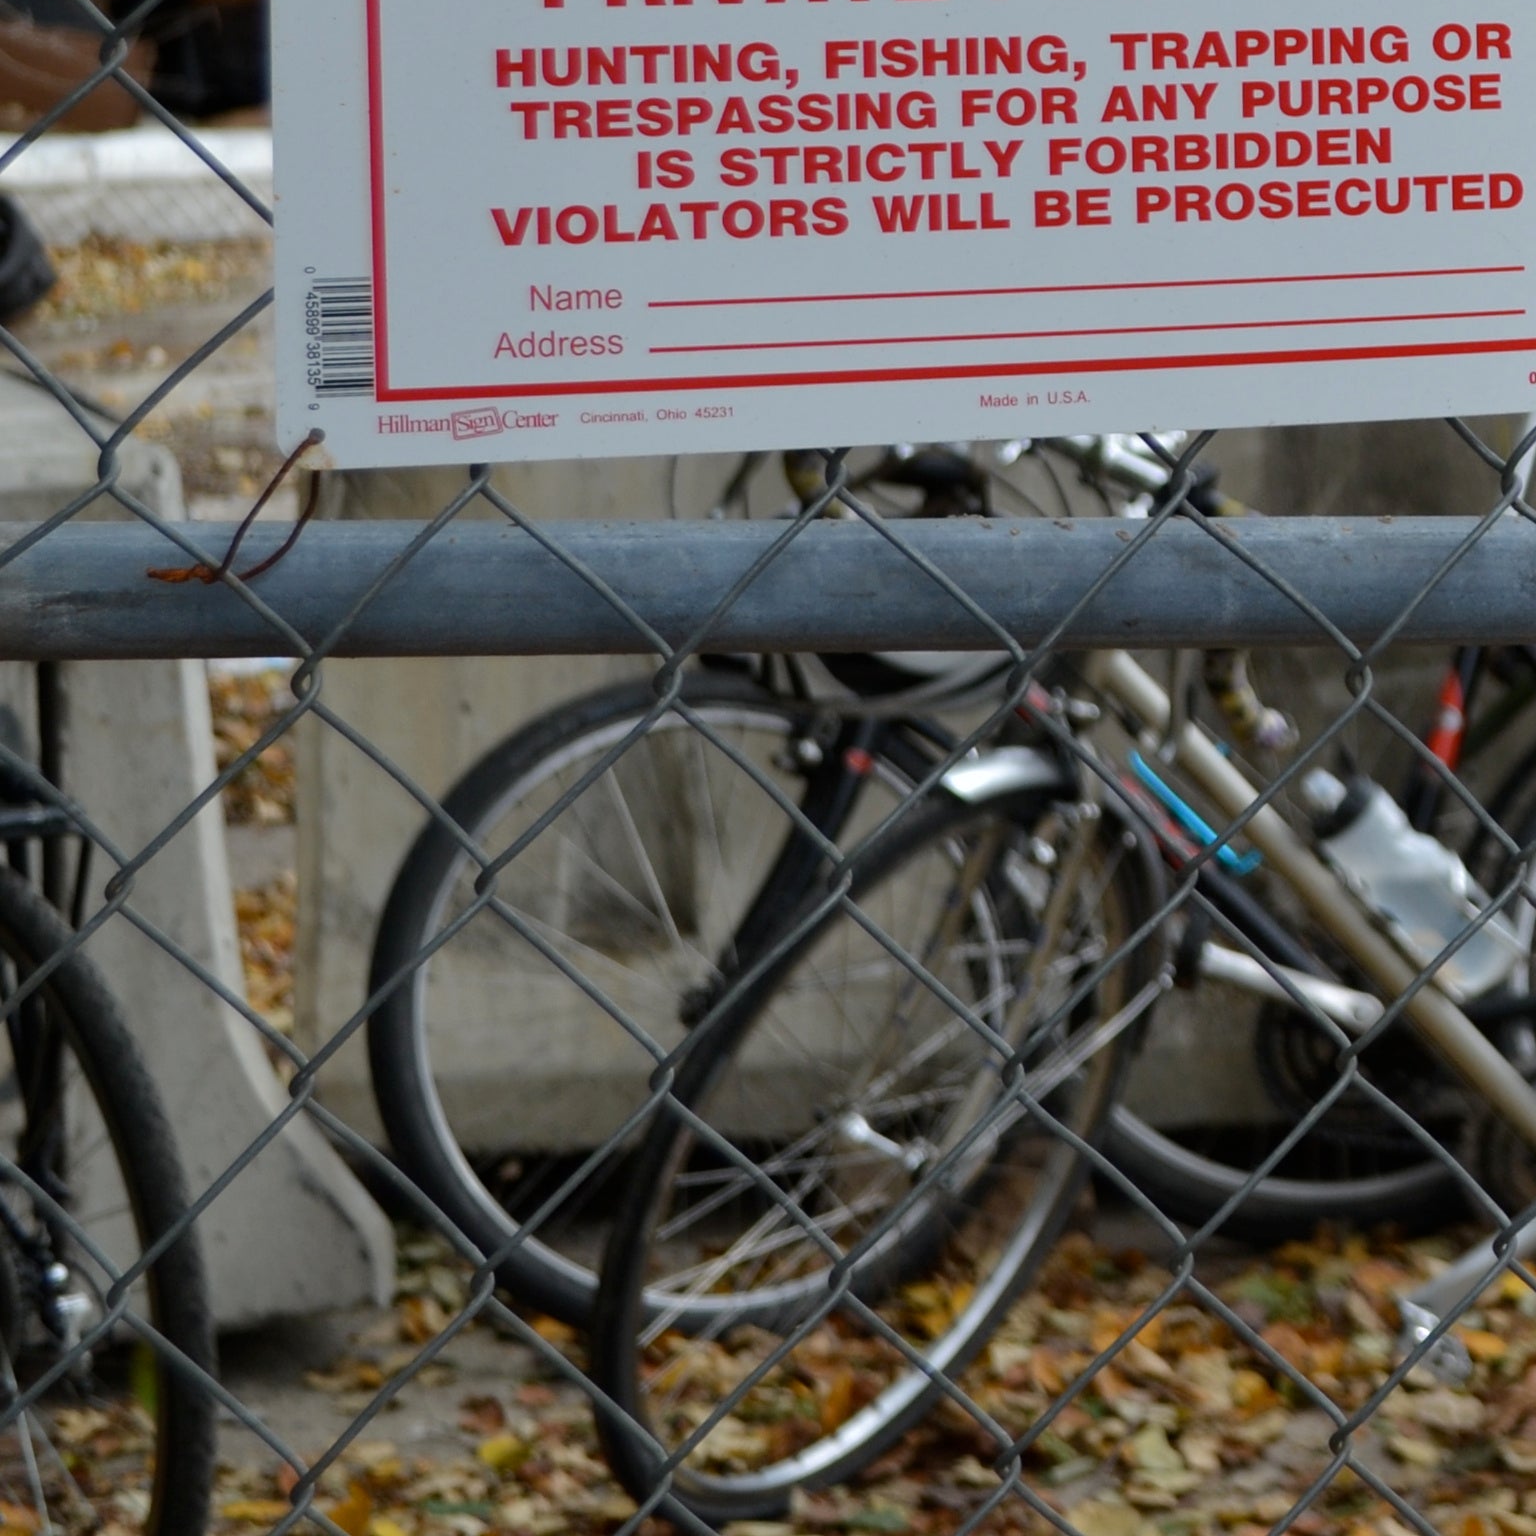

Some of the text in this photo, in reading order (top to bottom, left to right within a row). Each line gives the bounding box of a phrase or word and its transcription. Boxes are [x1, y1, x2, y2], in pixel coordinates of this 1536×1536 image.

[496, 23, 1512, 89] HUNTING, FISHING, TRAPPING OR
[510, 73, 1502, 140] TRESPASSING FOR ANY PURPOSE
[637, 127, 1392, 189] IS STRICTLY FORBIDDEN
[491, 173, 1524, 246] VIOLATORS WILL BE PROSECUTED
[530, 284, 622, 311] Name
[304, 266, 322, 411] 0 45899 38135 9
[494, 330, 624, 359] Address
[580, 406, 734, 425] Cincinnati, Ohio 45231
[980, 390, 1091, 406] Made in U.S.A.
[378, 410, 559, 434] Hillman Sign Center
